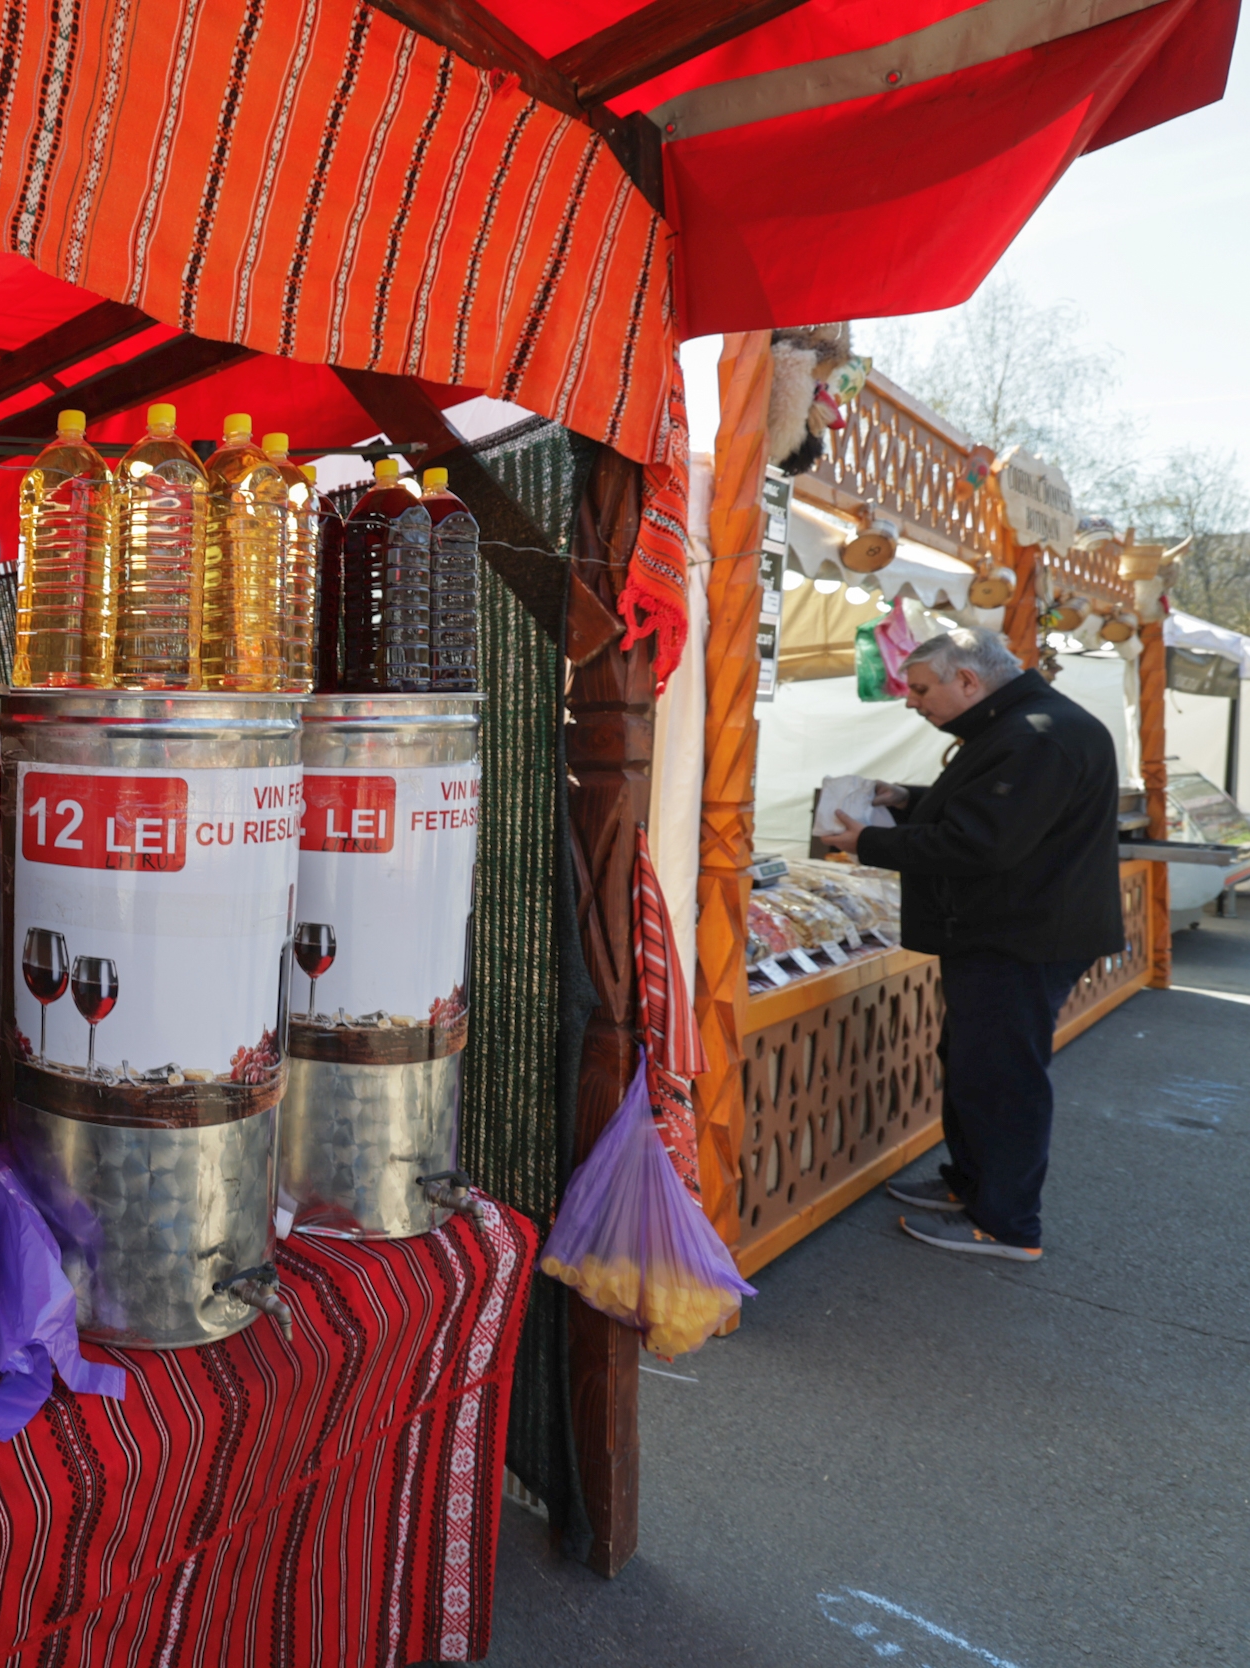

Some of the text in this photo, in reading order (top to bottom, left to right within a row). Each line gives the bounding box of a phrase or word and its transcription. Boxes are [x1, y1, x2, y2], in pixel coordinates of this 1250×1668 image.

[253, 785, 284, 809] VIN
[441, 780, 467, 801] VIN
[28, 796, 84, 850] 12
[106, 816, 177, 854] LEI
[195, 822, 234, 846] CU
[326, 808, 387, 839] LEI
